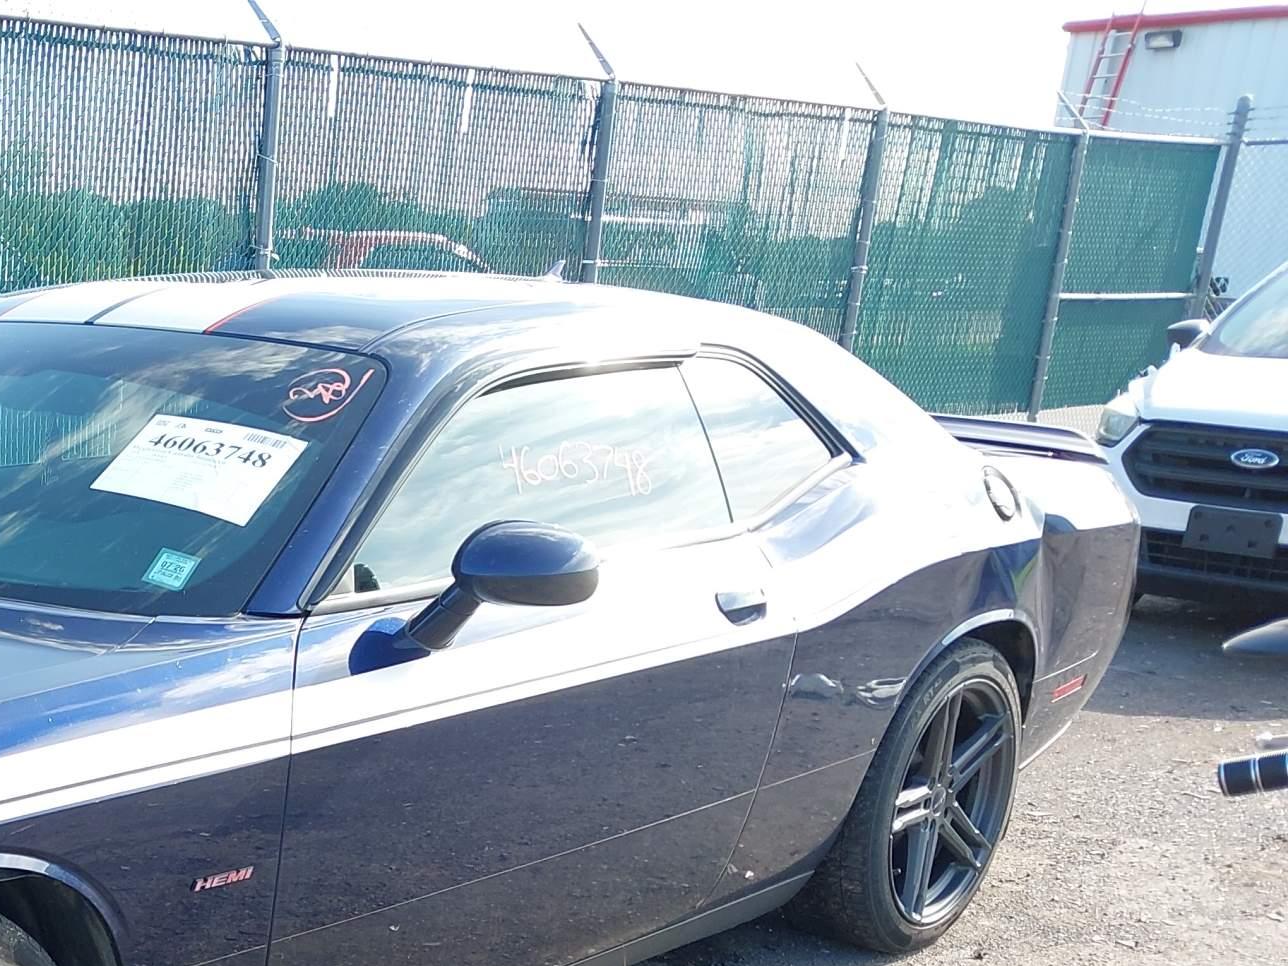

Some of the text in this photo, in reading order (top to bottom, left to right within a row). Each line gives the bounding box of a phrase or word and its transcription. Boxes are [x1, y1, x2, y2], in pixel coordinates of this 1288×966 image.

[149, 433, 272, 468] 46063748
[499, 441, 653, 496] 46063748
[192, 866, 254, 892] HEMI
